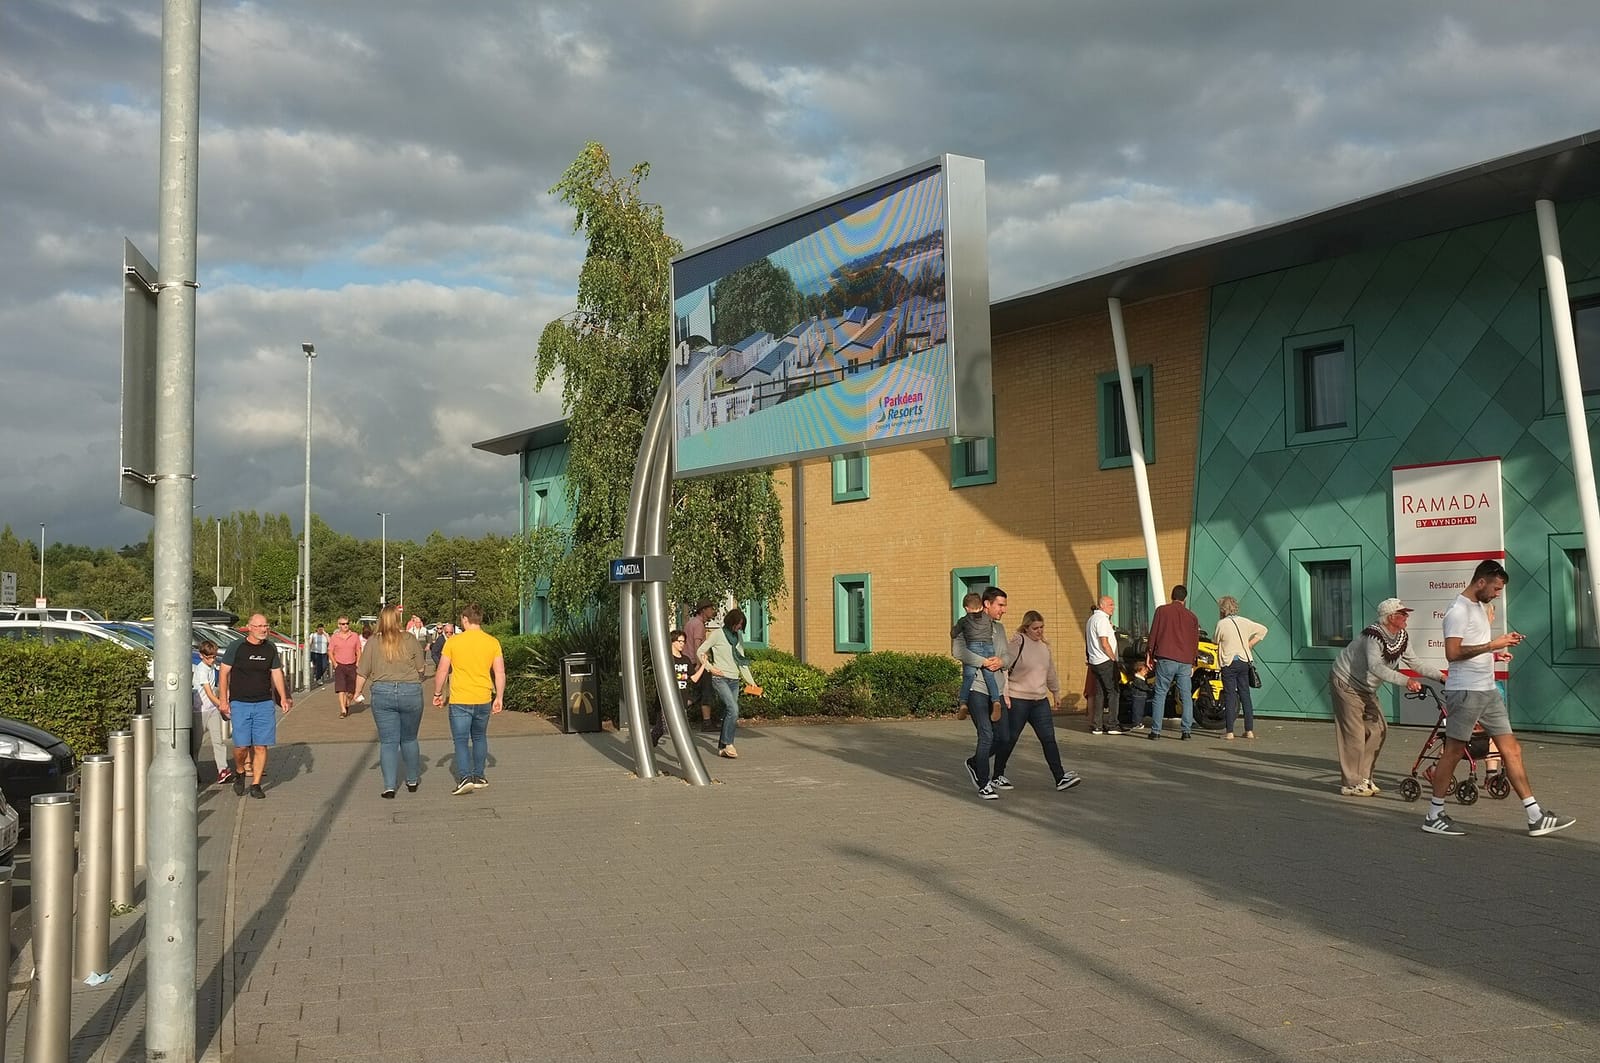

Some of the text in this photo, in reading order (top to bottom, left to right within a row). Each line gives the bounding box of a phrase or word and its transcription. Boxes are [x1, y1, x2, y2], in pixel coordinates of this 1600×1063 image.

[884, 392, 923, 408] Parkdean
[887, 404, 924, 420] Resorts
[1402, 493, 1490, 514] RAMADA
[1416, 517, 1476, 528] BY WYNDHAM
[615, 563, 641, 576] ADMEDIA
[1429, 581, 1466, 590] Restaurant
